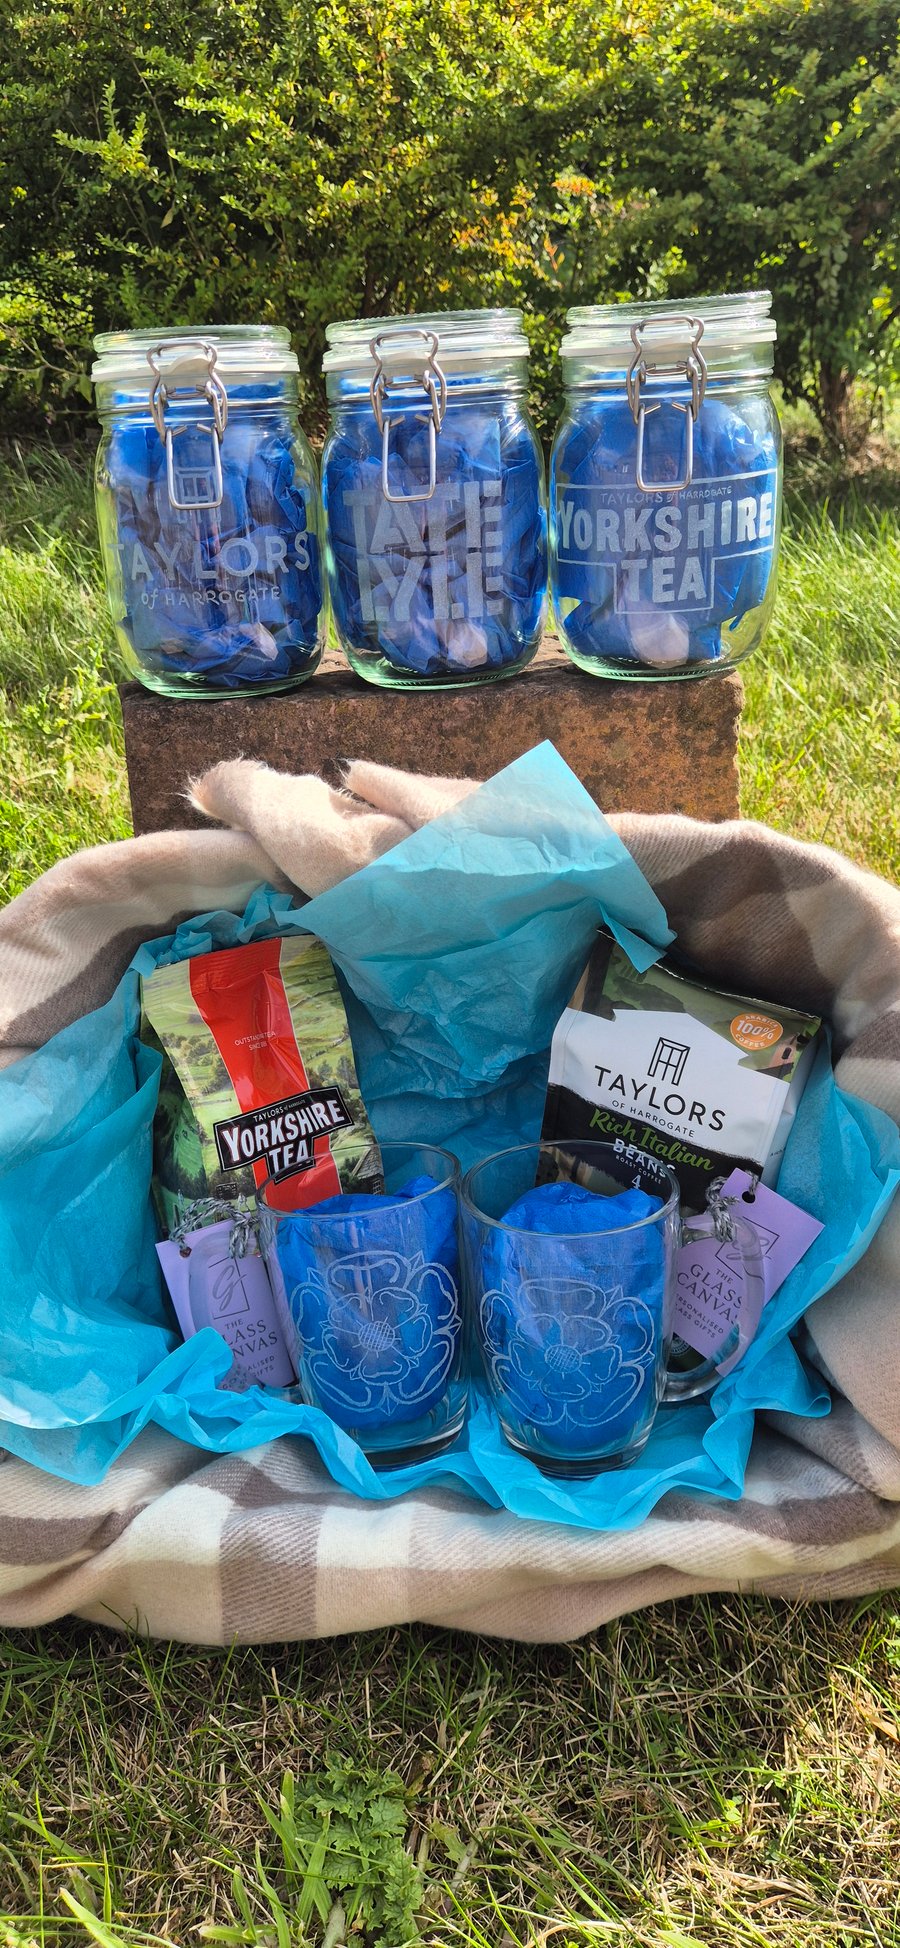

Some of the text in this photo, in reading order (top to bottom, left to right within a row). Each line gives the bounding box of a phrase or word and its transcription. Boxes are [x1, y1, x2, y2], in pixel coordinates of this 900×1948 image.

[600, 490, 663, 505] TAYLORS
[679, 485, 733, 500] HARROGATE
[343, 480, 503, 553] TATE
[557, 492, 774, 552] YORKSHIRE
[107, 530, 311, 581] TAYLORS
[141, 586, 281, 609] of HARROGATE
[356, 552, 504, 622] LYLE
[621, 556, 708, 603] TEA
[736, 1019, 778, 1041] 100%
[253, 1106, 284, 1123] TAYLORS
[594, 1065, 726, 1132] TAYLORS
[222, 1099, 345, 1163] YORKSHIRE
[611, 1099, 695, 1138] OF HARROGATE
[269, 1140, 309, 1174] TEA
[589, 1108, 714, 1171] Rich Italian
[615, 1154, 662, 1185] ROAST COFFEE
[690, 1263, 742, 1309] GLASS
[716, 1268, 734, 1285] THE
[224, 1319, 244, 1330] THE
[676, 1293, 724, 1334] RSONALISED
[694, 1320, 716, 1339] GIFTS
[232, 1331, 278, 1360] NVAS
